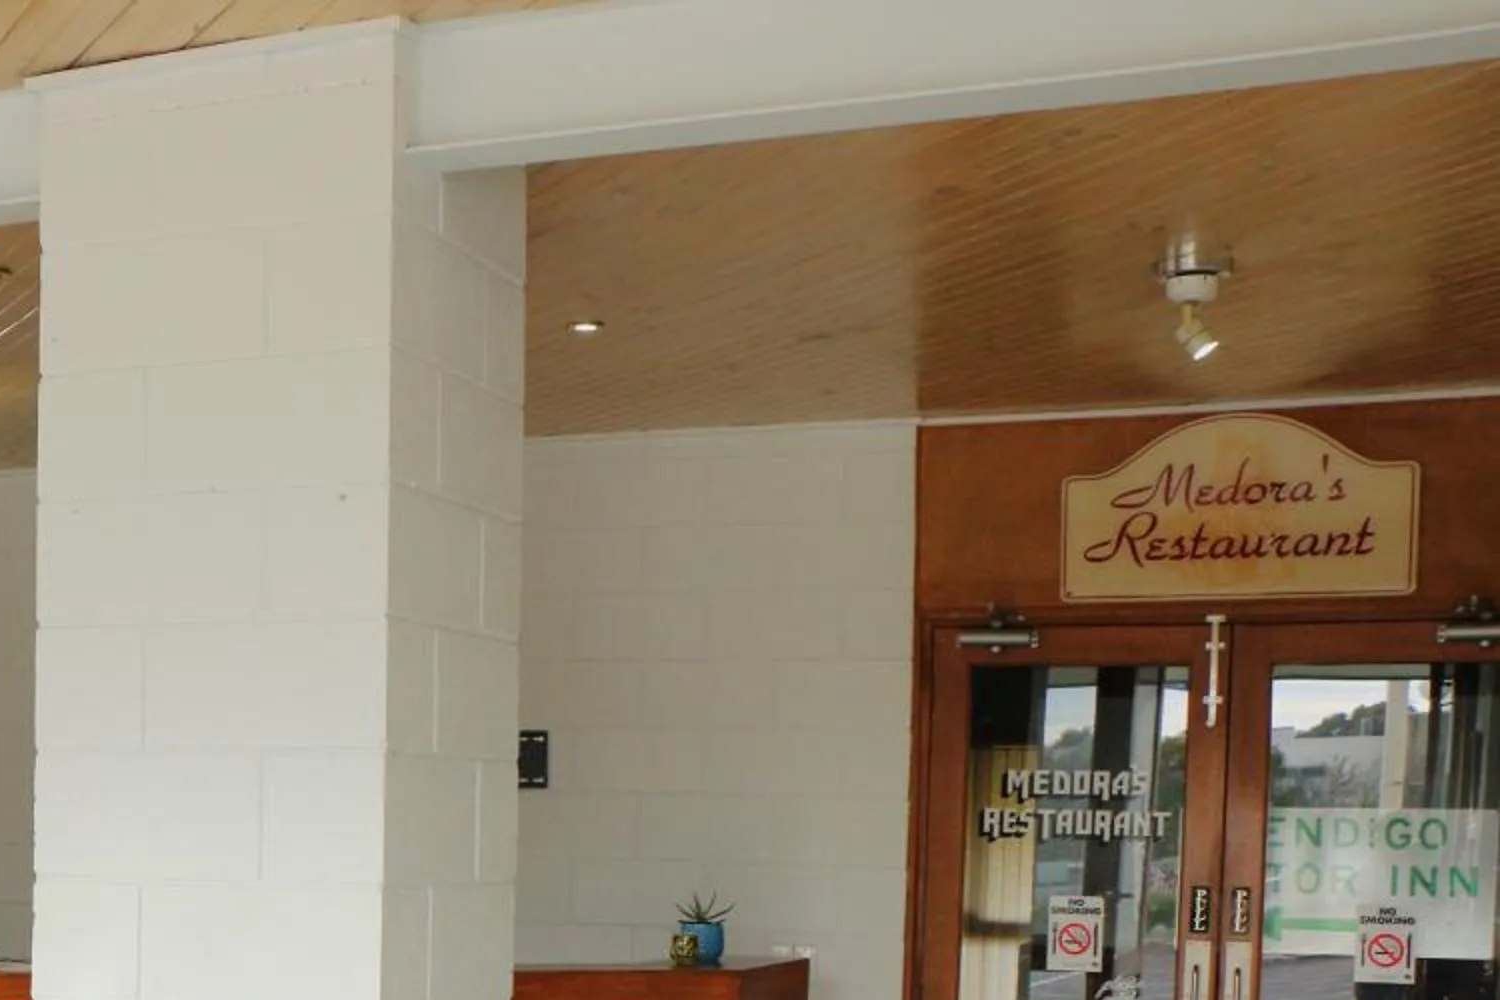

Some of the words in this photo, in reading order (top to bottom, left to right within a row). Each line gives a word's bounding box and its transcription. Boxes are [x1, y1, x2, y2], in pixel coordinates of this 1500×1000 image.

[1110, 454, 1348, 512] Medora's
[1083, 511, 1376, 568] Restaurant
[980, 805, 1173, 842] RESTAURANT
[1390, 864, 1479, 898] INN
[1067, 898, 1085, 907] NO
[1379, 907, 1397, 916] NO
